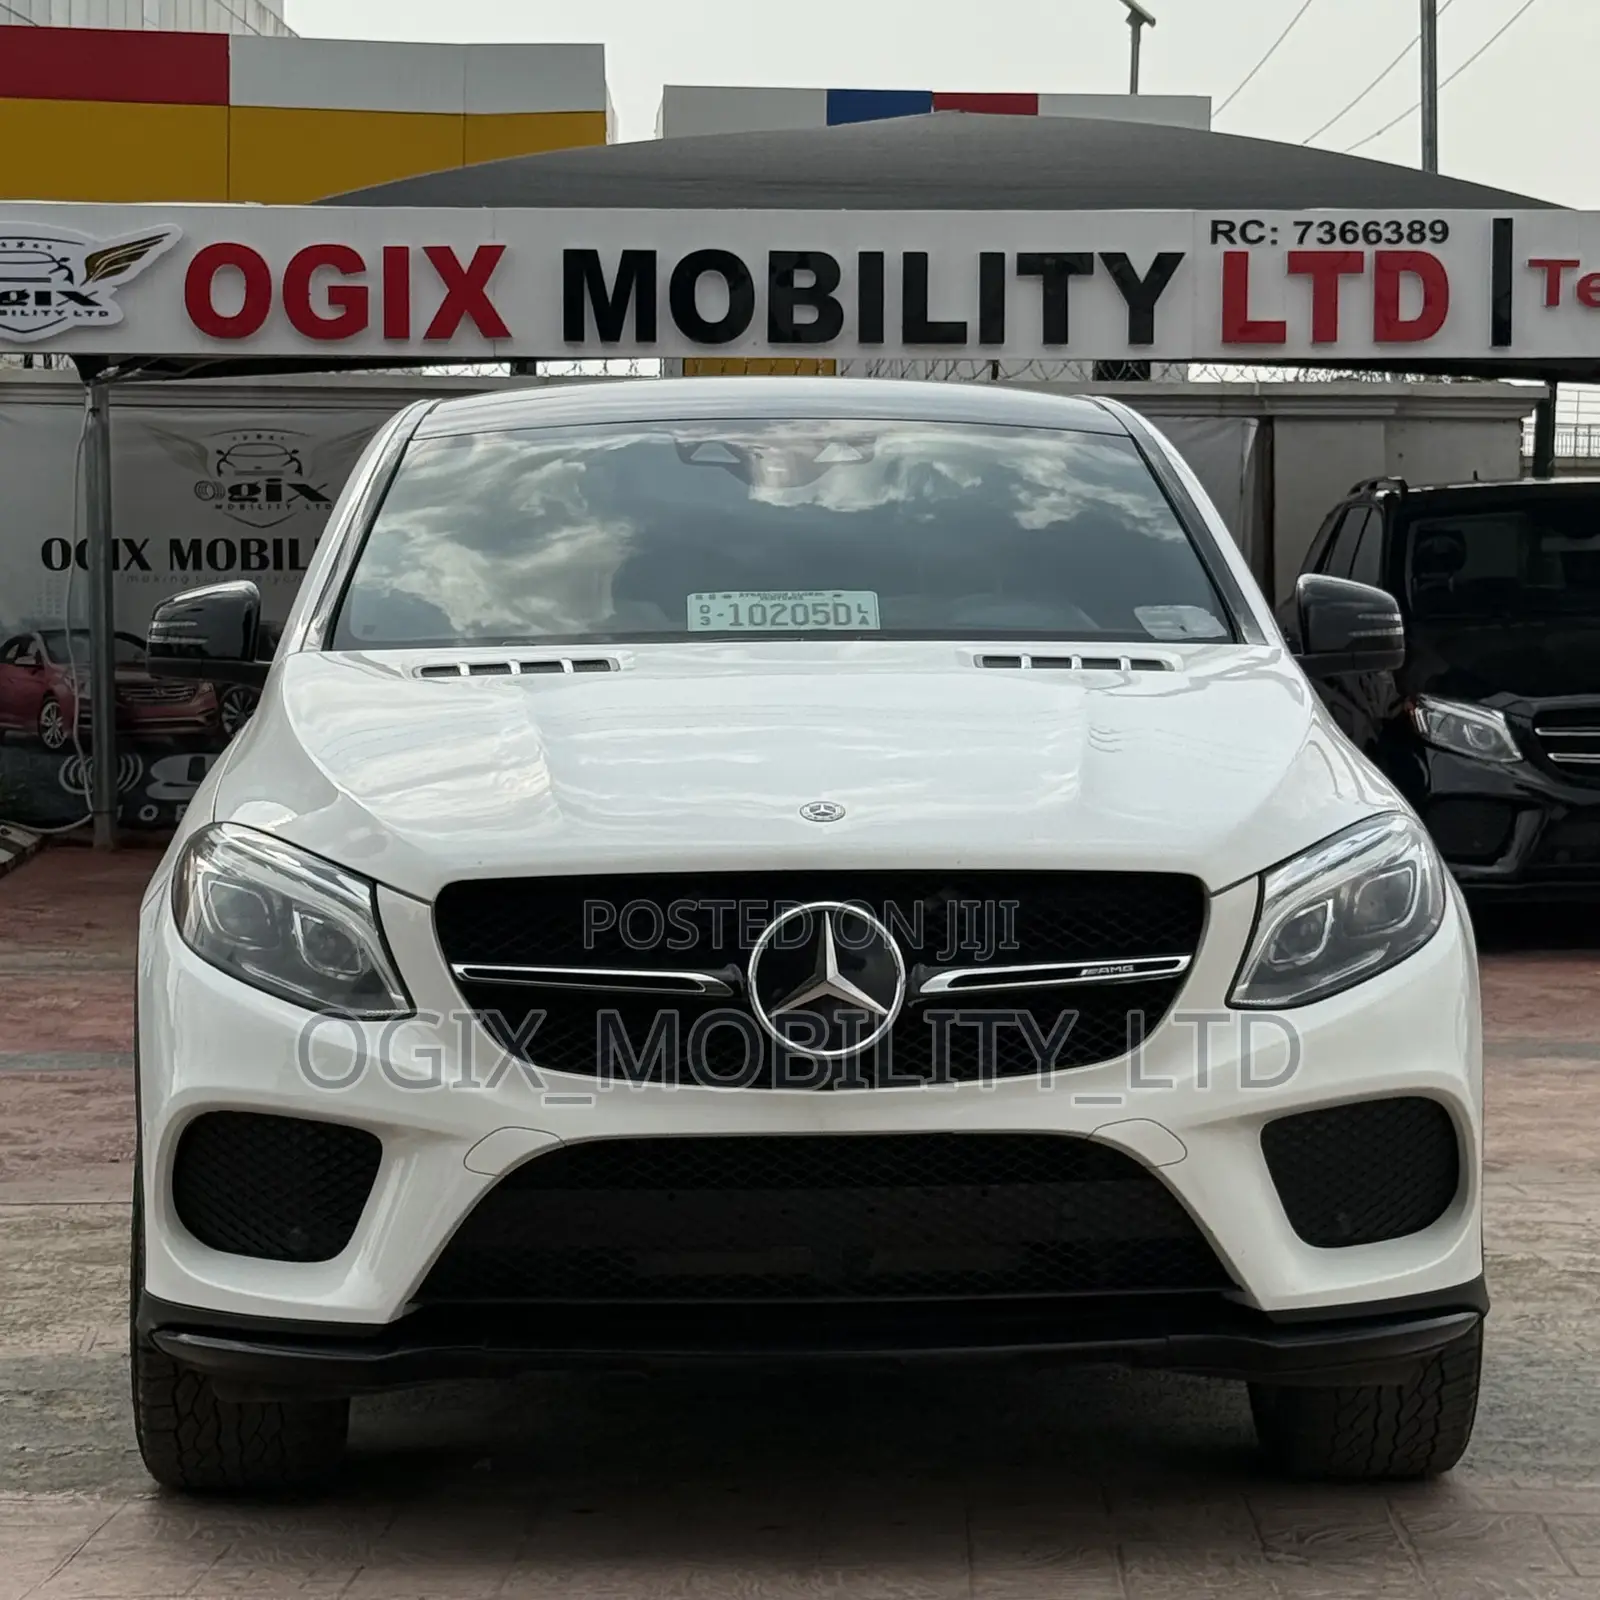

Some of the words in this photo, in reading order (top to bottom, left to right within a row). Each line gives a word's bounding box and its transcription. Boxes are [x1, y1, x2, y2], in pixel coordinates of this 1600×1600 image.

[1210, 219, 1279, 245] RC:
[1293, 219, 1450, 245] 7366389
[184, 241, 513, 341] OGIX
[563, 248, 1186, 345] MOBILITY
[1221, 250, 1450, 344] LTD
[69, 309, 109, 317] LTD
[169, 537, 320, 572] MOBIL
